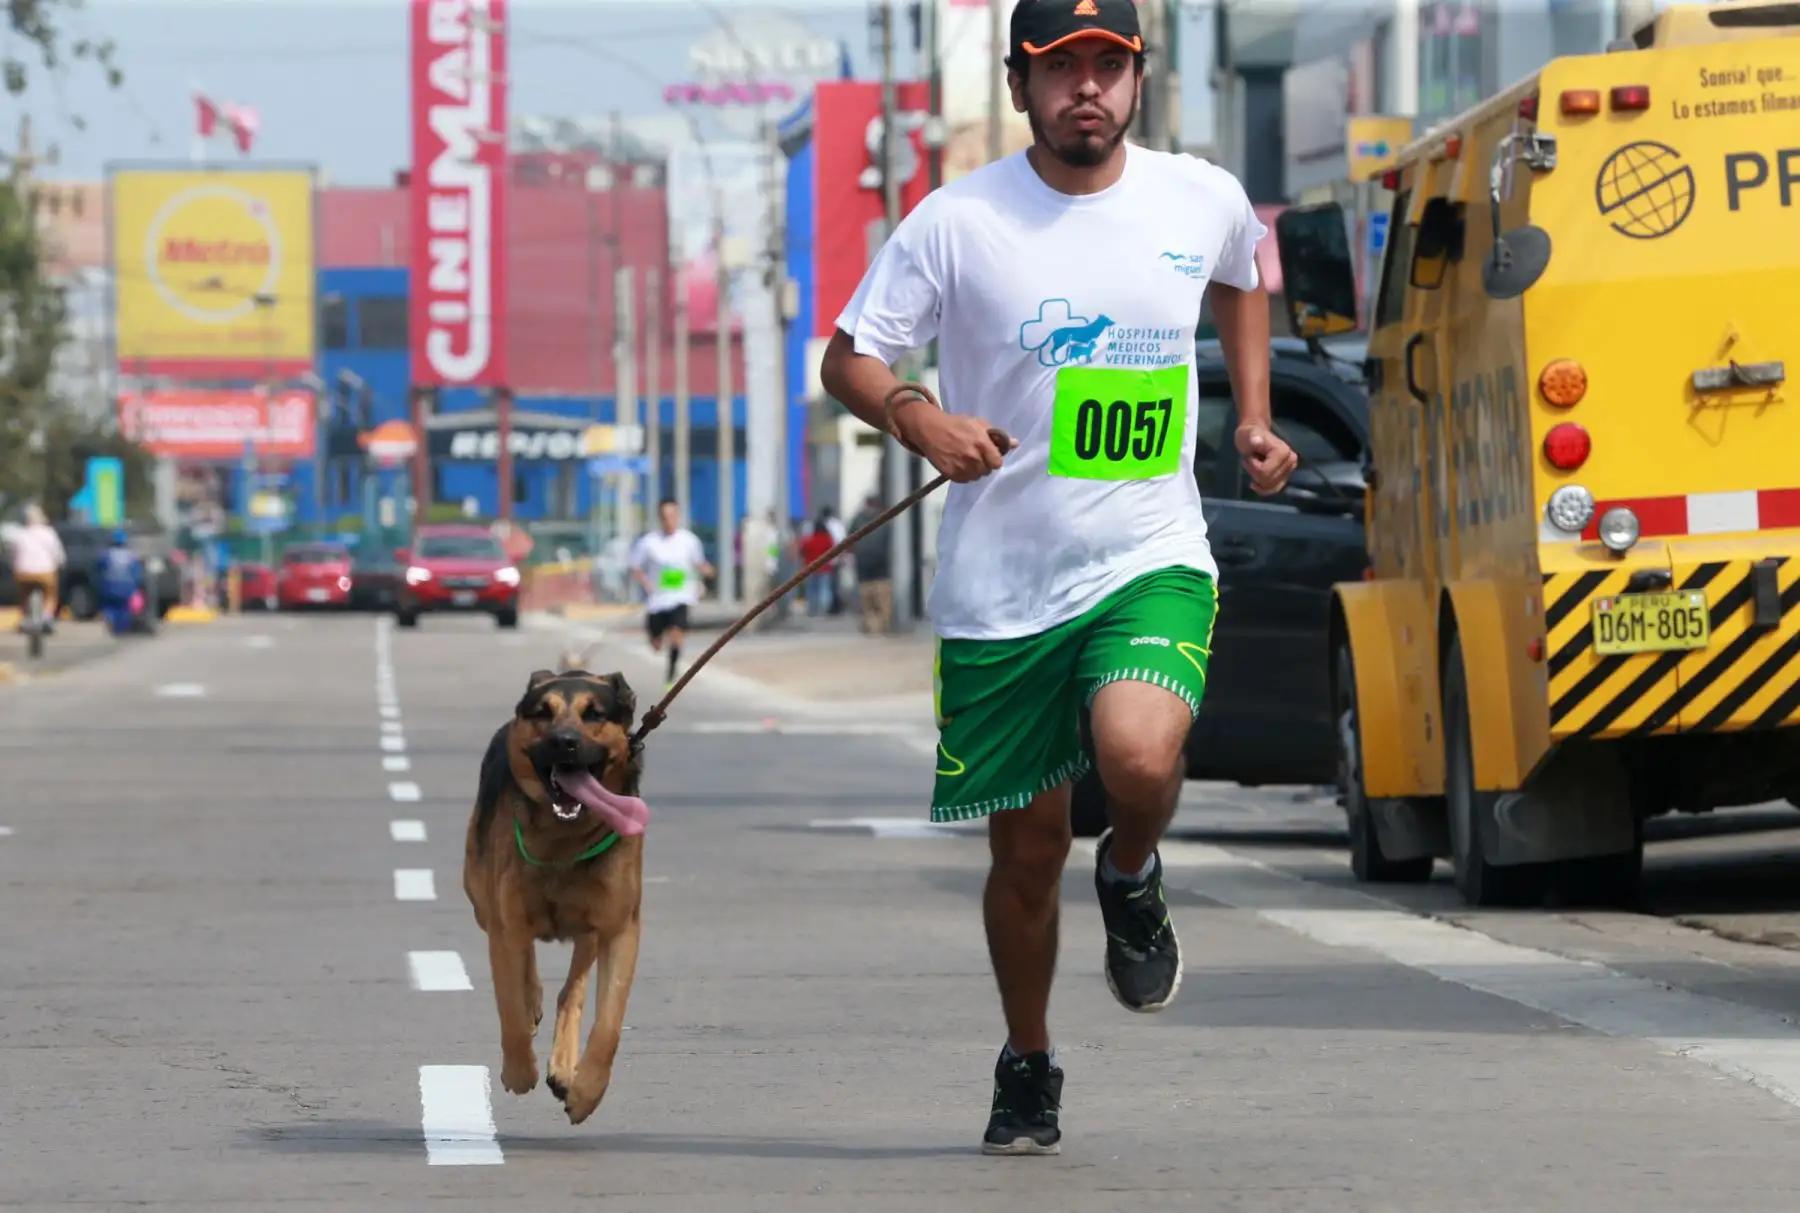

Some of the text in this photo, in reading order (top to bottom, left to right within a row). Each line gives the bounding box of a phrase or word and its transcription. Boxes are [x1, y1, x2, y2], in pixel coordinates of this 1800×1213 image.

[1672, 92, 1800, 120] Lo estamos filma
[1189, 254, 1204, 263] san
[1174, 263, 1203, 275] miguel
[1108, 328, 1181, 340] HOSPITALES
[1075, 398, 1173, 461] 0057
[1599, 607, 1703, 643] D6M-805
